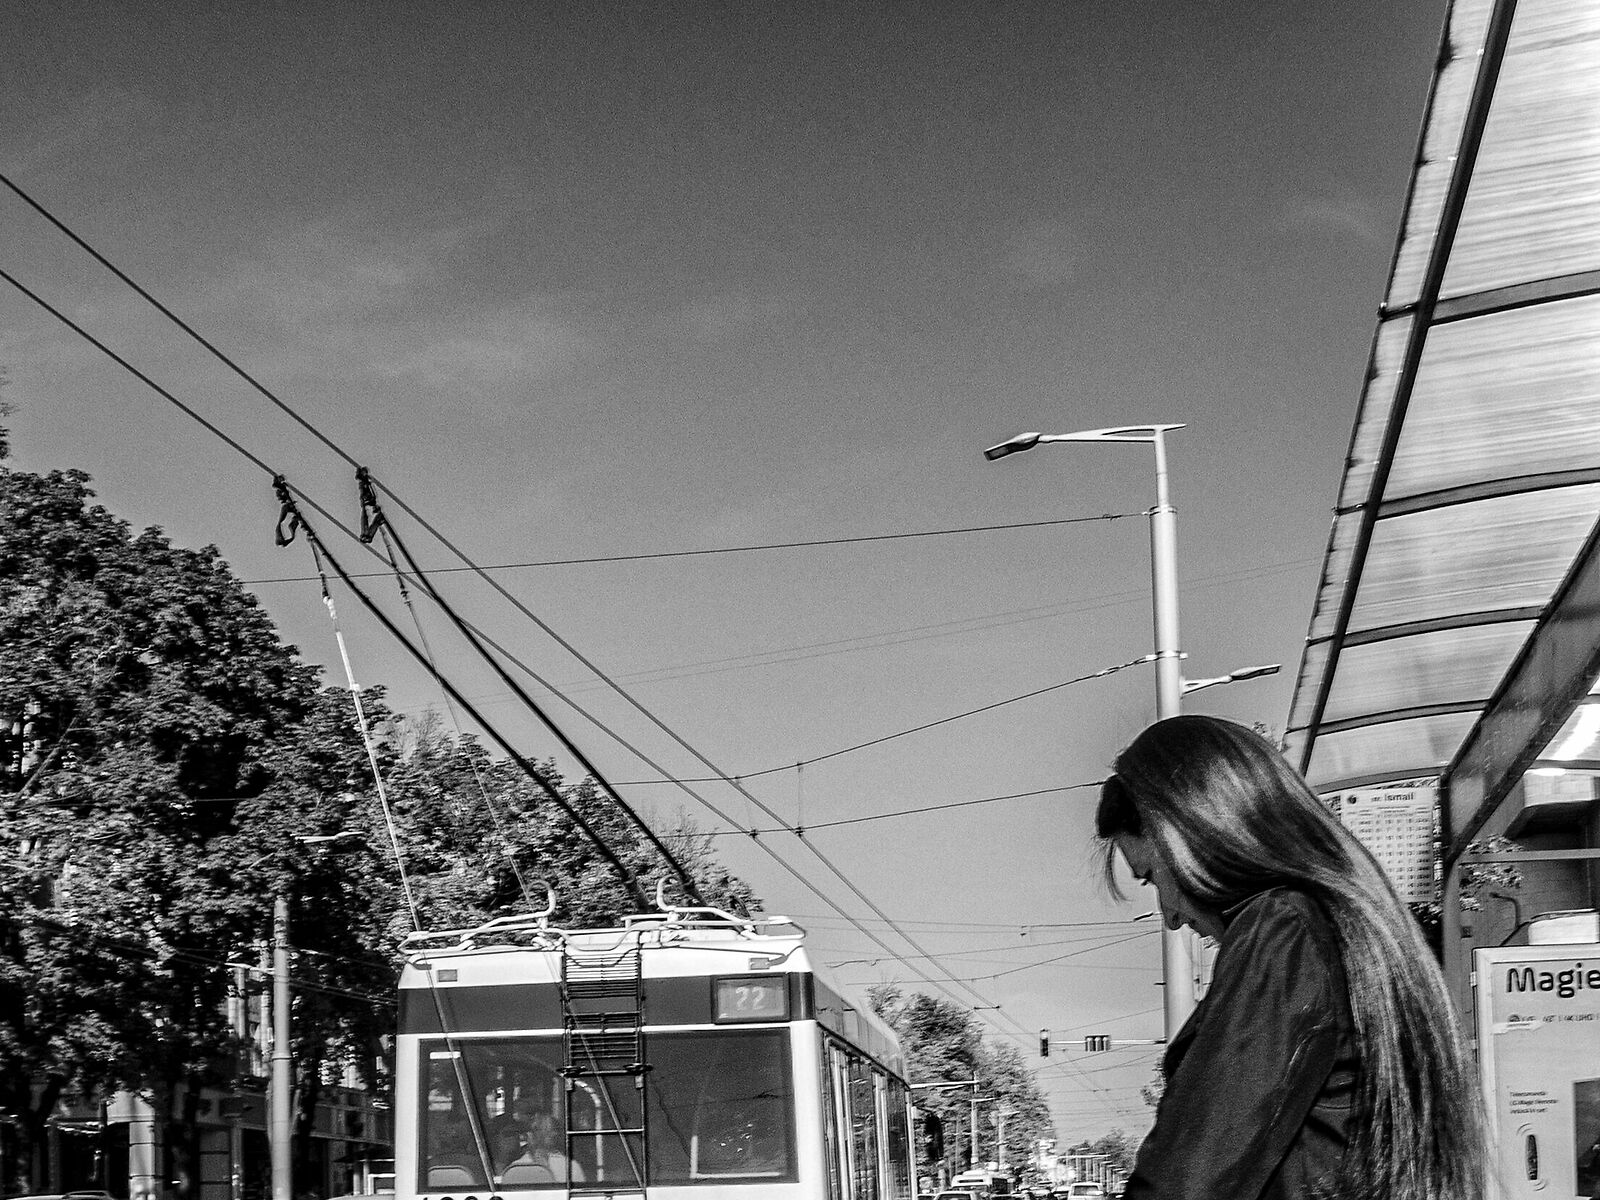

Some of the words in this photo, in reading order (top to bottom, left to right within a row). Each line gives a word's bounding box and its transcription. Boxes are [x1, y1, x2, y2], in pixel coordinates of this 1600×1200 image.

[1384, 792, 1415, 801] Ismail
[1507, 962, 1600, 998] Magie
[735, 986, 766, 1011] 22
